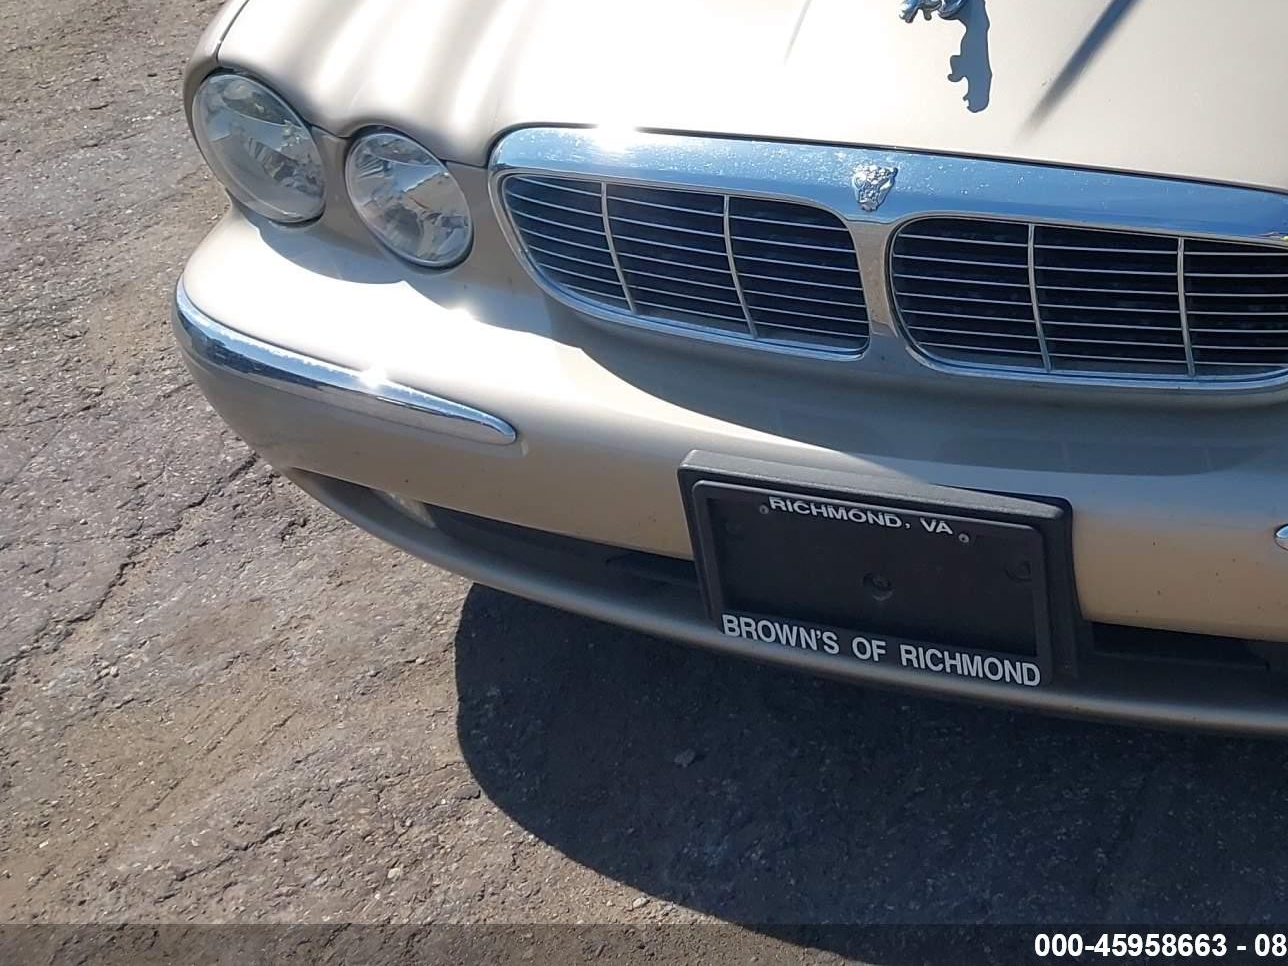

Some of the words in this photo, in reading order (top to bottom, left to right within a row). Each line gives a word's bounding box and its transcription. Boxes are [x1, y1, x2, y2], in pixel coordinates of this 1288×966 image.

[768, 496, 911, 529] RICHMOND,
[919, 519, 953, 536] VA
[721, 614, 841, 655] BROWN'S
[852, 636, 886, 662] OF
[900, 644, 1042, 687] RICHMOND
